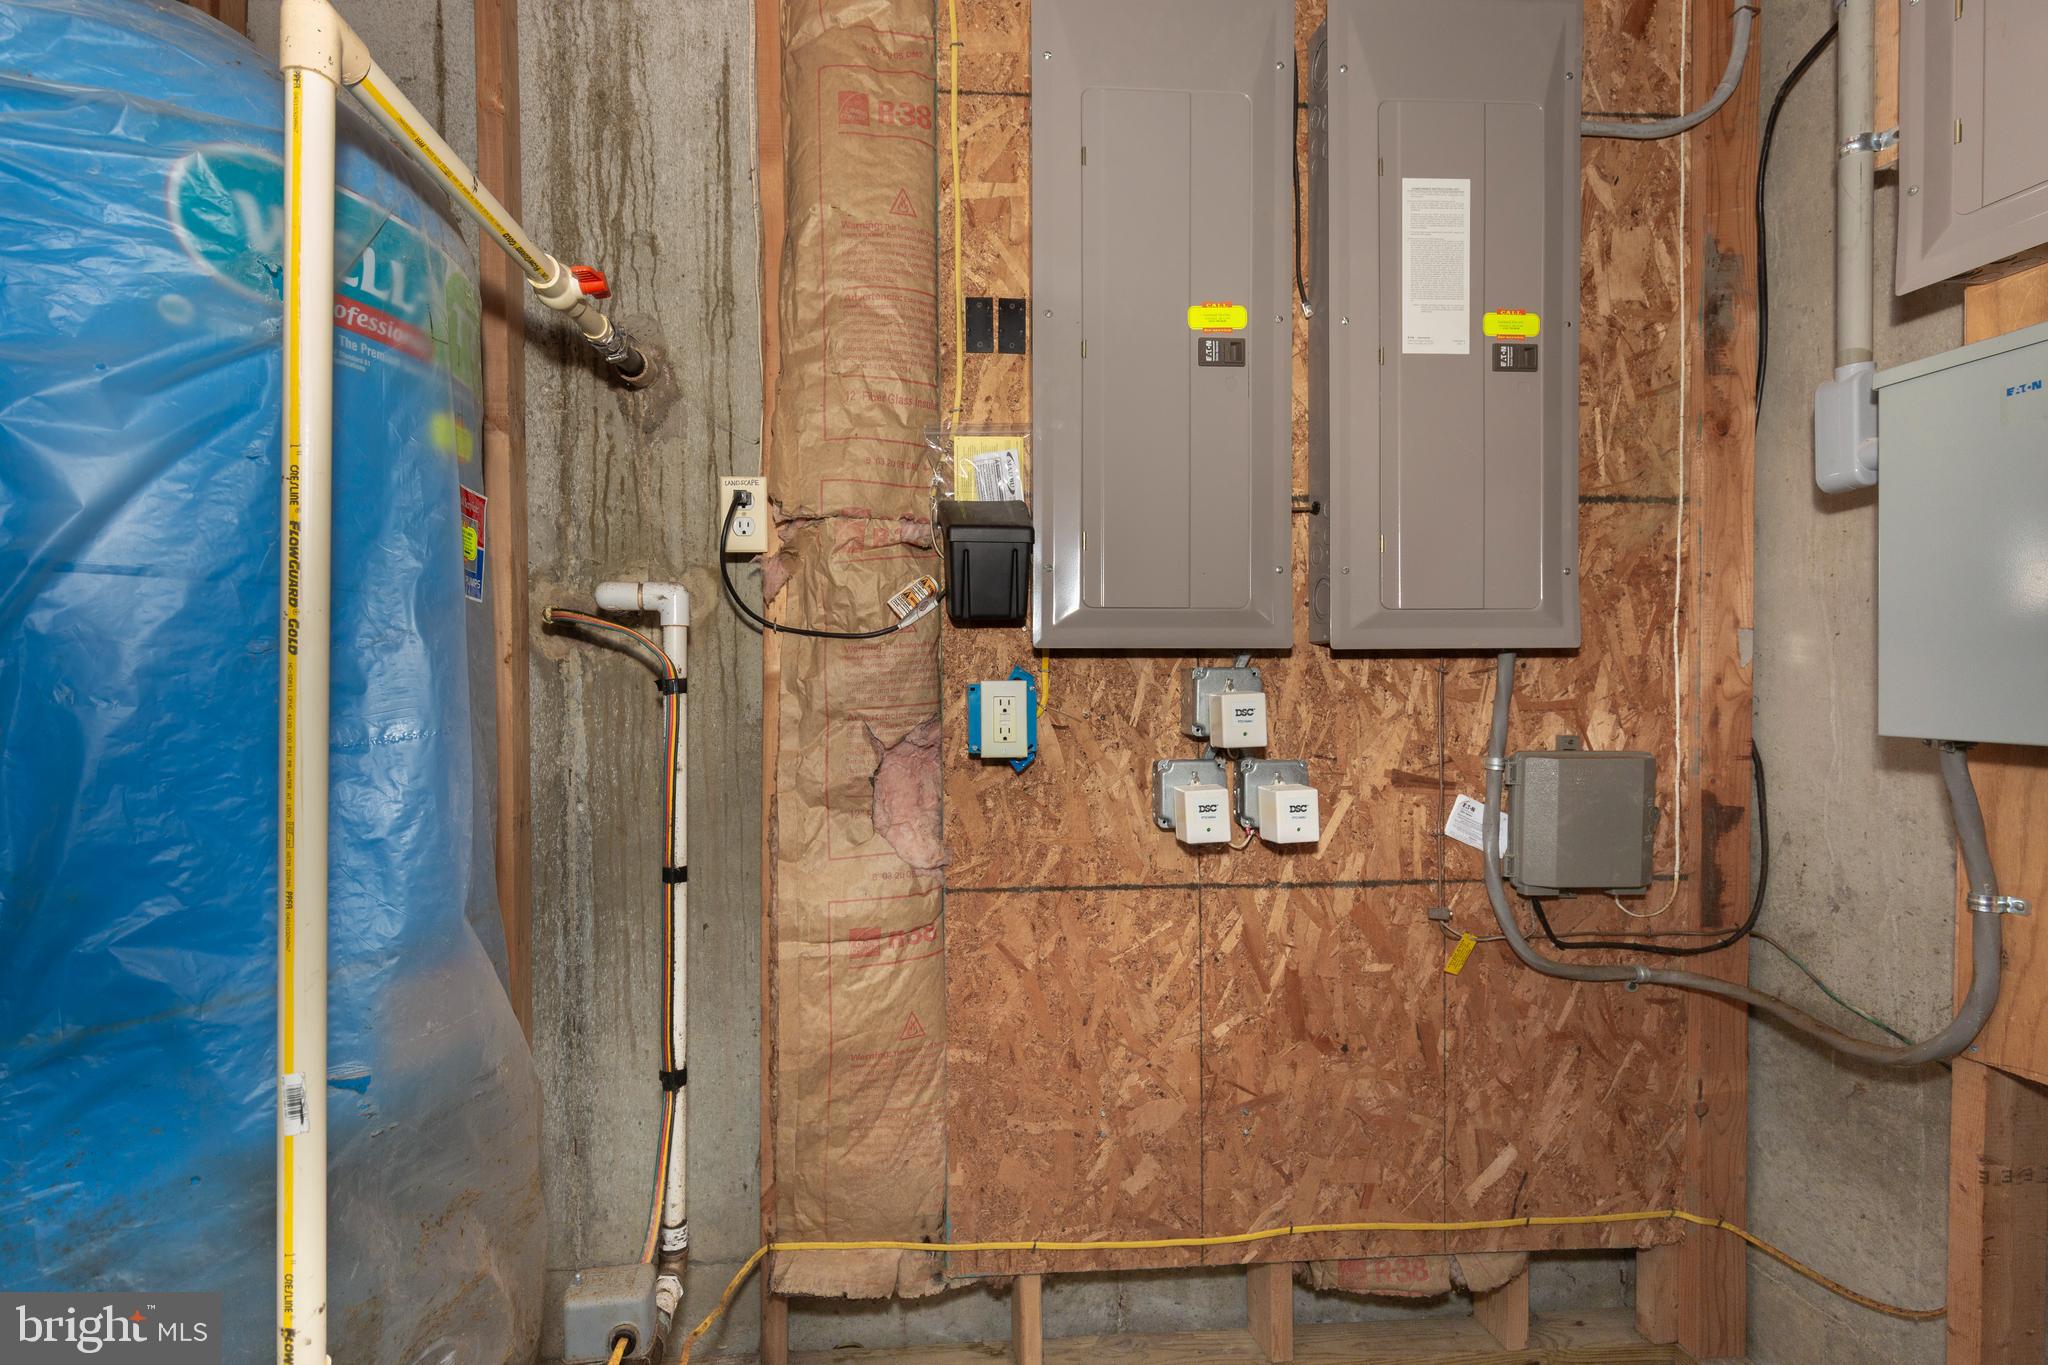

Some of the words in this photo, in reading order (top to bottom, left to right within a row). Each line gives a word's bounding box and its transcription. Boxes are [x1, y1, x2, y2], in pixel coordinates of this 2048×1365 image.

[502, 232, 517, 246] GOLD
[338, 335, 358, 351] The
[2006, 379, 2042, 397] EATON
[888, 393, 913, 406] Glass
[724, 479, 760, 487] LANDSCAPE
[289, 521, 301, 608] FLOWGUARD
[288, 618, 300, 656] GOLD
[1235, 708, 1254, 717] DSC
[1198, 804, 1217, 813] DSC
[1289, 804, 1307, 813] DSC
[285, 891, 293, 910] PPFA
